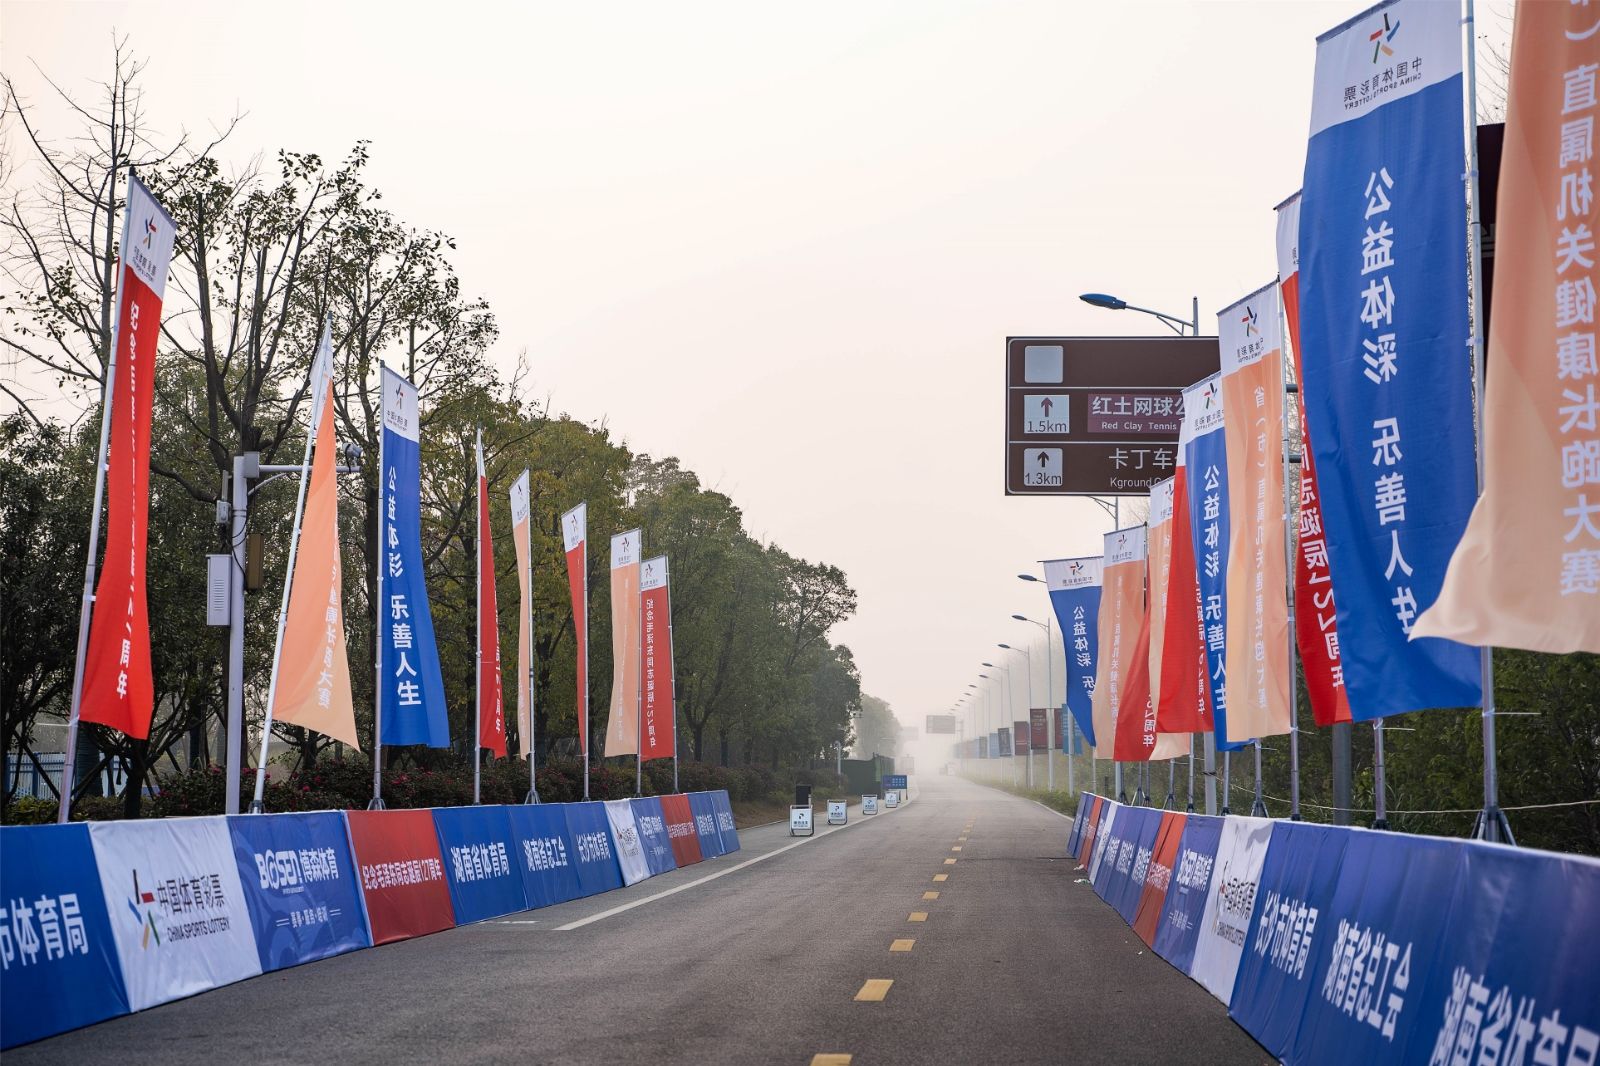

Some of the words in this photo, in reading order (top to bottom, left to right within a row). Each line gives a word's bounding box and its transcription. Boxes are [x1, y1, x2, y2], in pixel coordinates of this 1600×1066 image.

[1027, 420, 1067, 433] 1.5km
[1101, 421, 1118, 431] Red
[1123, 421, 1143, 432] Clay
[1149, 421, 1177, 431] Tennis
[1108, 448, 1178, 470] 卡丁车
[1024, 472, 1062, 485] 1.3km
[391, 594, 422, 706] 乐善人生
[299, 847, 339, 882] 博森体育
[450, 842, 510, 884] 湖南省体育局
[522, 835, 568, 872] 湖南省总工会
[576, 831, 610, 863] 长沙市体育局
[362, 858, 442, 890] 纪念毛泽东同志诞辰127周年
[157, 874, 225, 918] 中国体育彩票
[1254, 891, 1319, 980] 长沙市体育局
[1321, 918, 1413, 1043] 湖南省总工会
